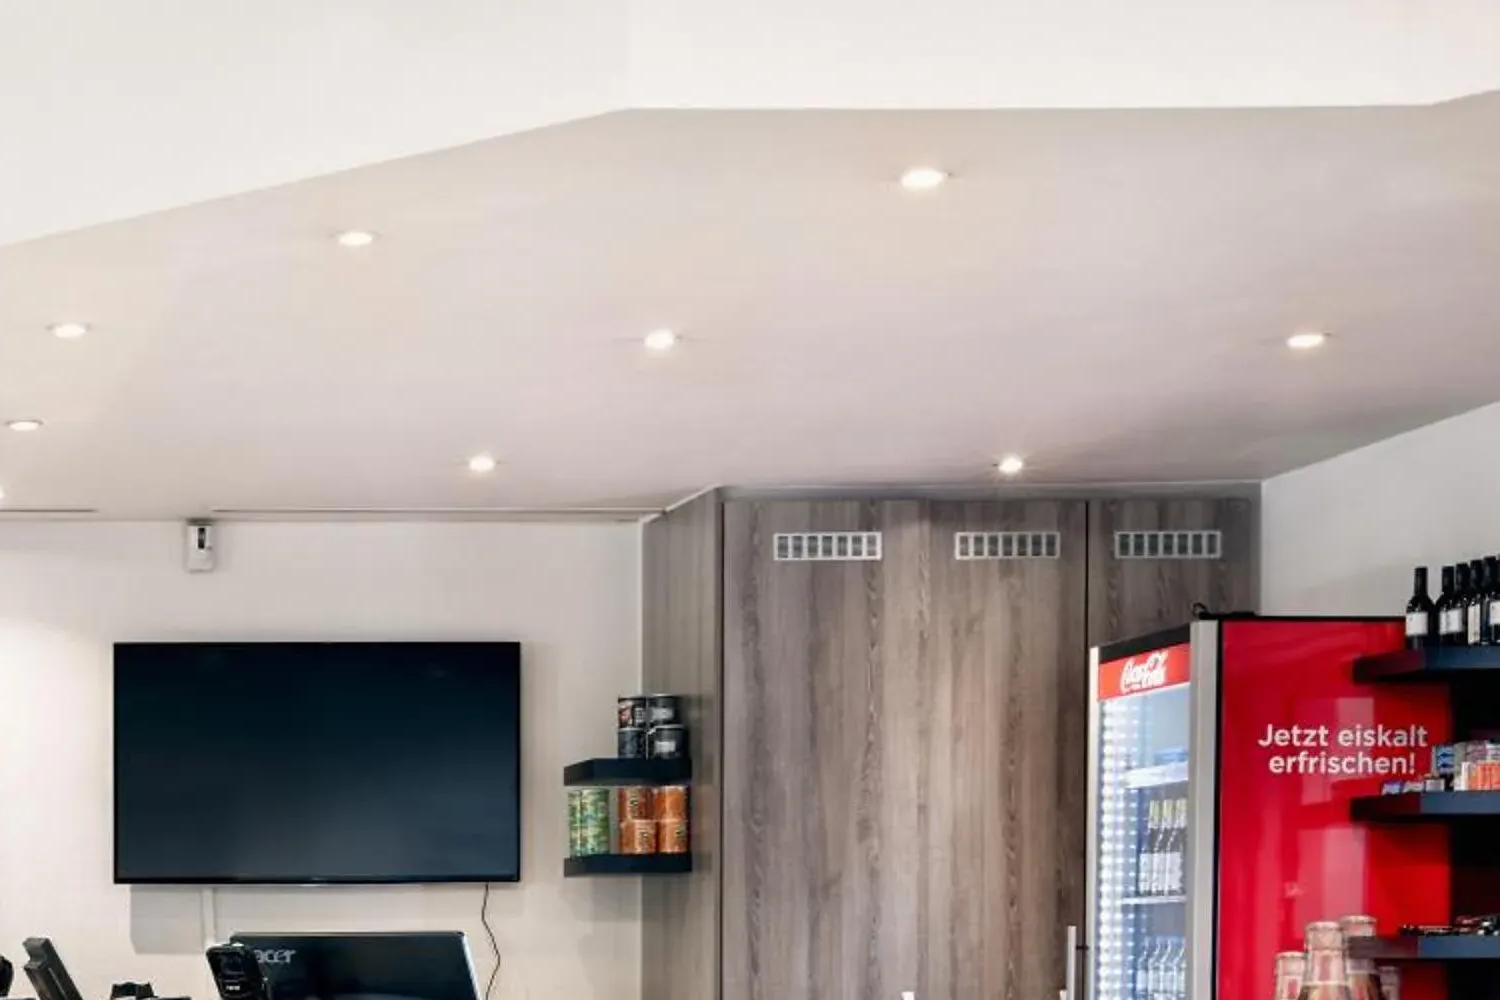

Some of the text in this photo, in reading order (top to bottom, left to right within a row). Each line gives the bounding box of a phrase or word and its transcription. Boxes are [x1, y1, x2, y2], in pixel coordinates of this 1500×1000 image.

[1258, 723, 1428, 747] Jetzt eiskalt
[1268, 751, 1416, 775] erfrischen!
[253, 949, 297, 964] acer
